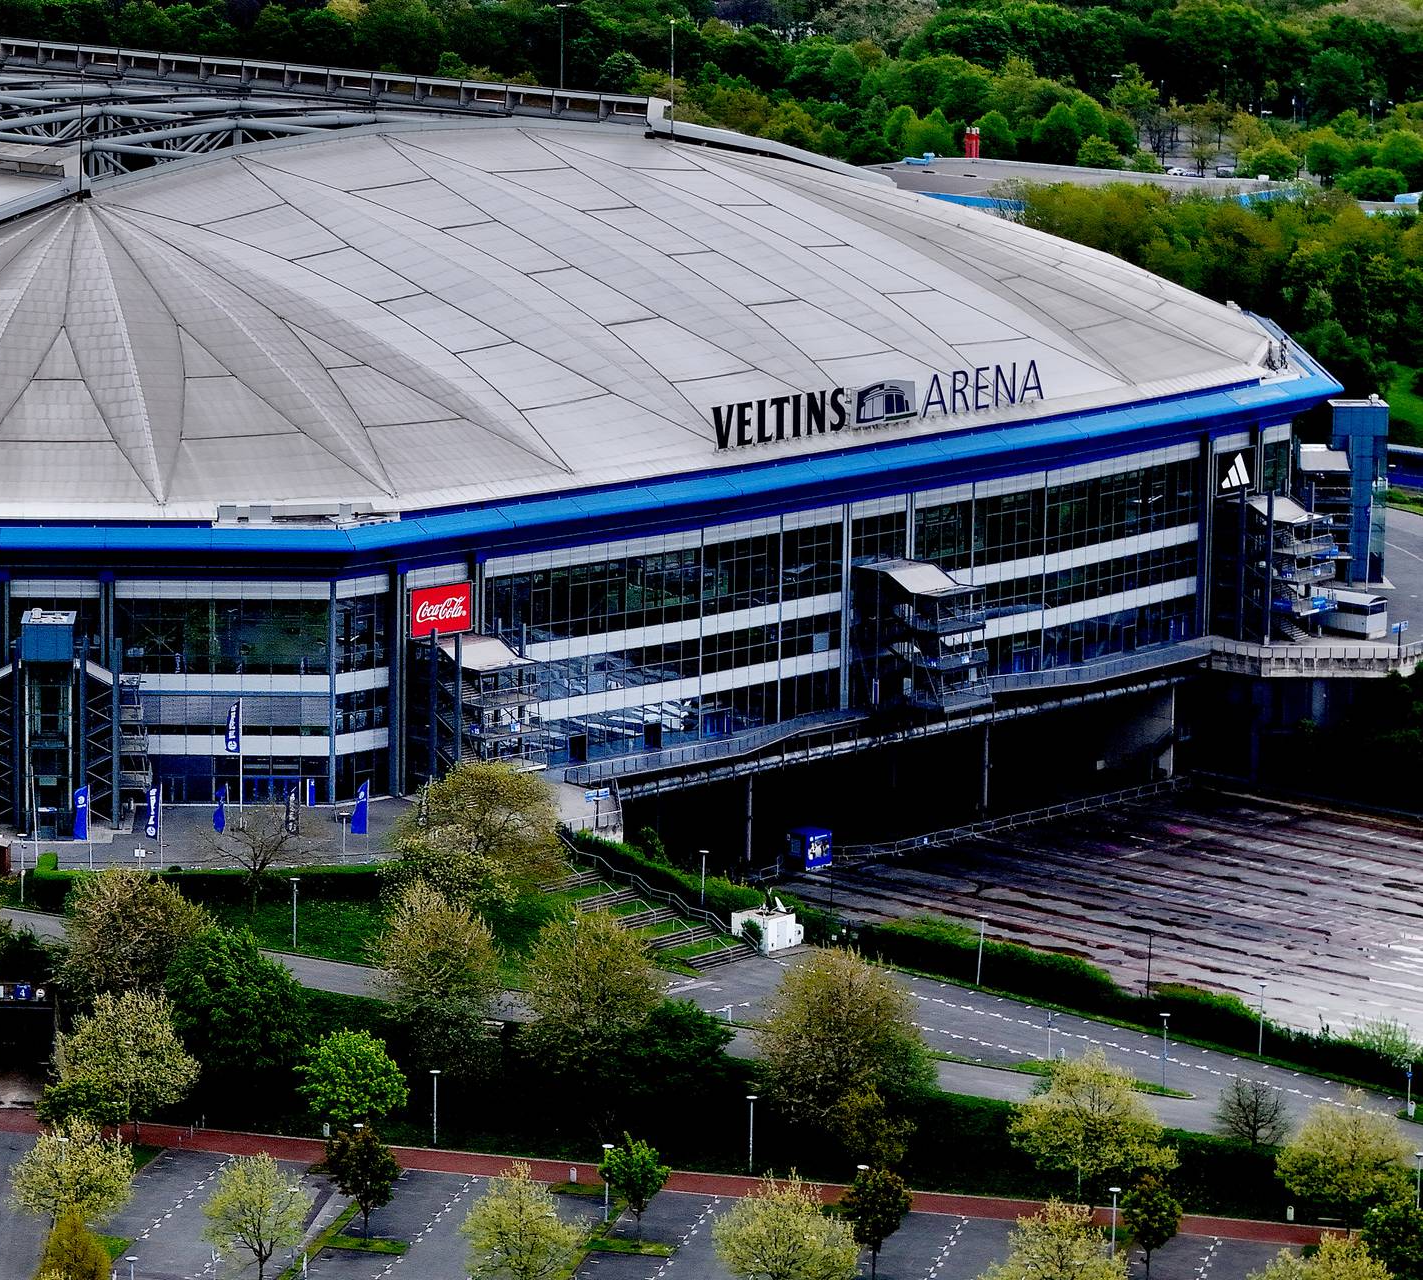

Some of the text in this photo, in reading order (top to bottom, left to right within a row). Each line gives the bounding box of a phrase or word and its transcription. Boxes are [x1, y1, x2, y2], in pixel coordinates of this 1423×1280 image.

[710, 359, 1045, 450] VELTINS ARENA
[19, 989, 26, 997] 4
